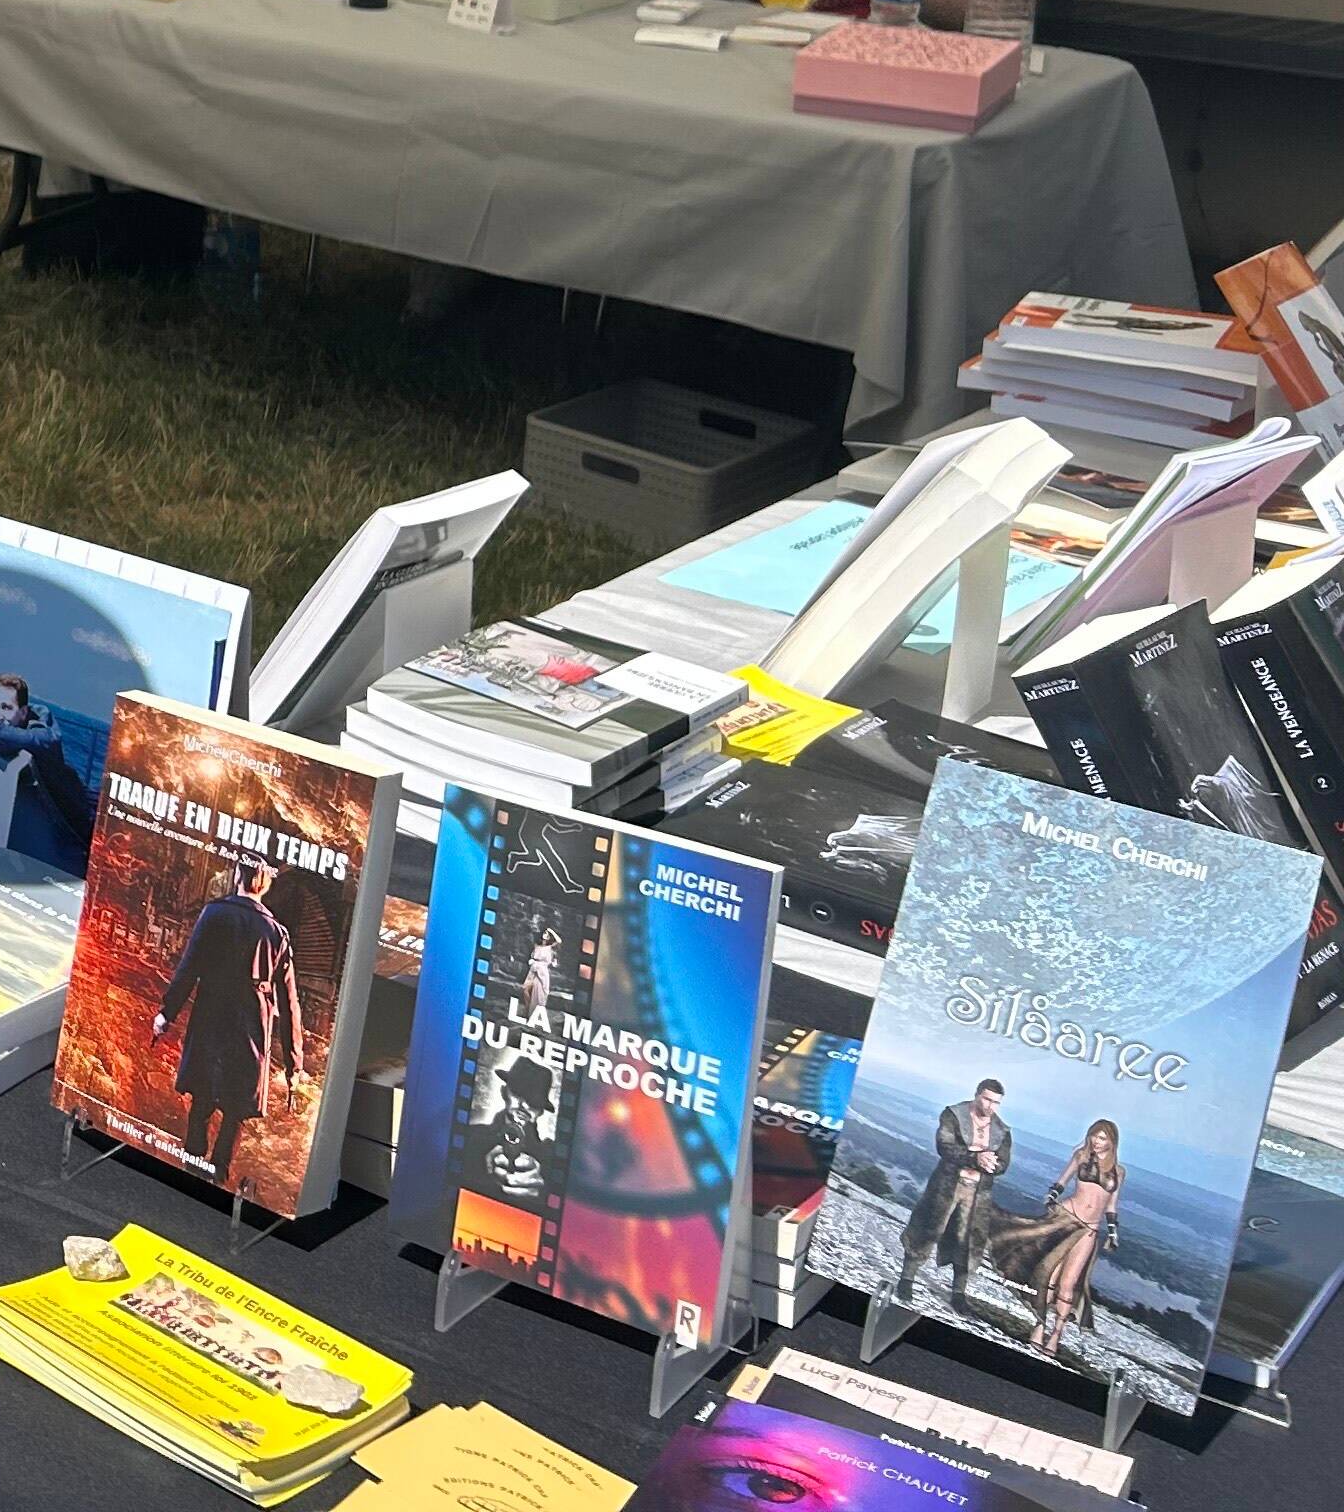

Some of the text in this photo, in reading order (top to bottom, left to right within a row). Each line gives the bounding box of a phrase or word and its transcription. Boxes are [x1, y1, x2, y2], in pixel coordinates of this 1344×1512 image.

[1129, 633, 1178, 668] MARTINEZ
[1215, 623, 1272, 648] MARTINEZ
[1023, 679, 1079, 702] MARTINEZ
[1249, 656, 1314, 760] LA VENGEANCE
[183, 735, 283, 778] Michel Cherchi
[1317, 777, 1328, 789] 2
[107, 803, 126, 820] Une
[125, 811, 164, 835] nouvelle
[163, 826, 206, 850] aventure
[203, 840, 219, 854] de
[218, 844, 240, 863] Rob
[108, 771, 350, 882] TRAQUE EN DEUX TEMPS
[1021, 811, 1210, 883] MICHEL CHERCHI
[638, 878, 743, 923] CHERCHI
[655, 863, 745, 904] MICHEL
[508, 995, 724, 1087] LA MARQUE
[460, 1013, 718, 1119] DU REPROCHE
[105, 1110, 216, 1174] Thriller d'anticipation
[97, 1308, 164, 1349] Association
[154, 1250, 352, 1362] La Tribu de l'Encre Fraîche
[678, 1302, 699, 1334] R
[798, 1361, 909, 1404] Luca Pavese
[815, 1445, 970, 1508] Patrick CHAUVET
[879, 1432, 993, 1480] Patrick CHAUVET
